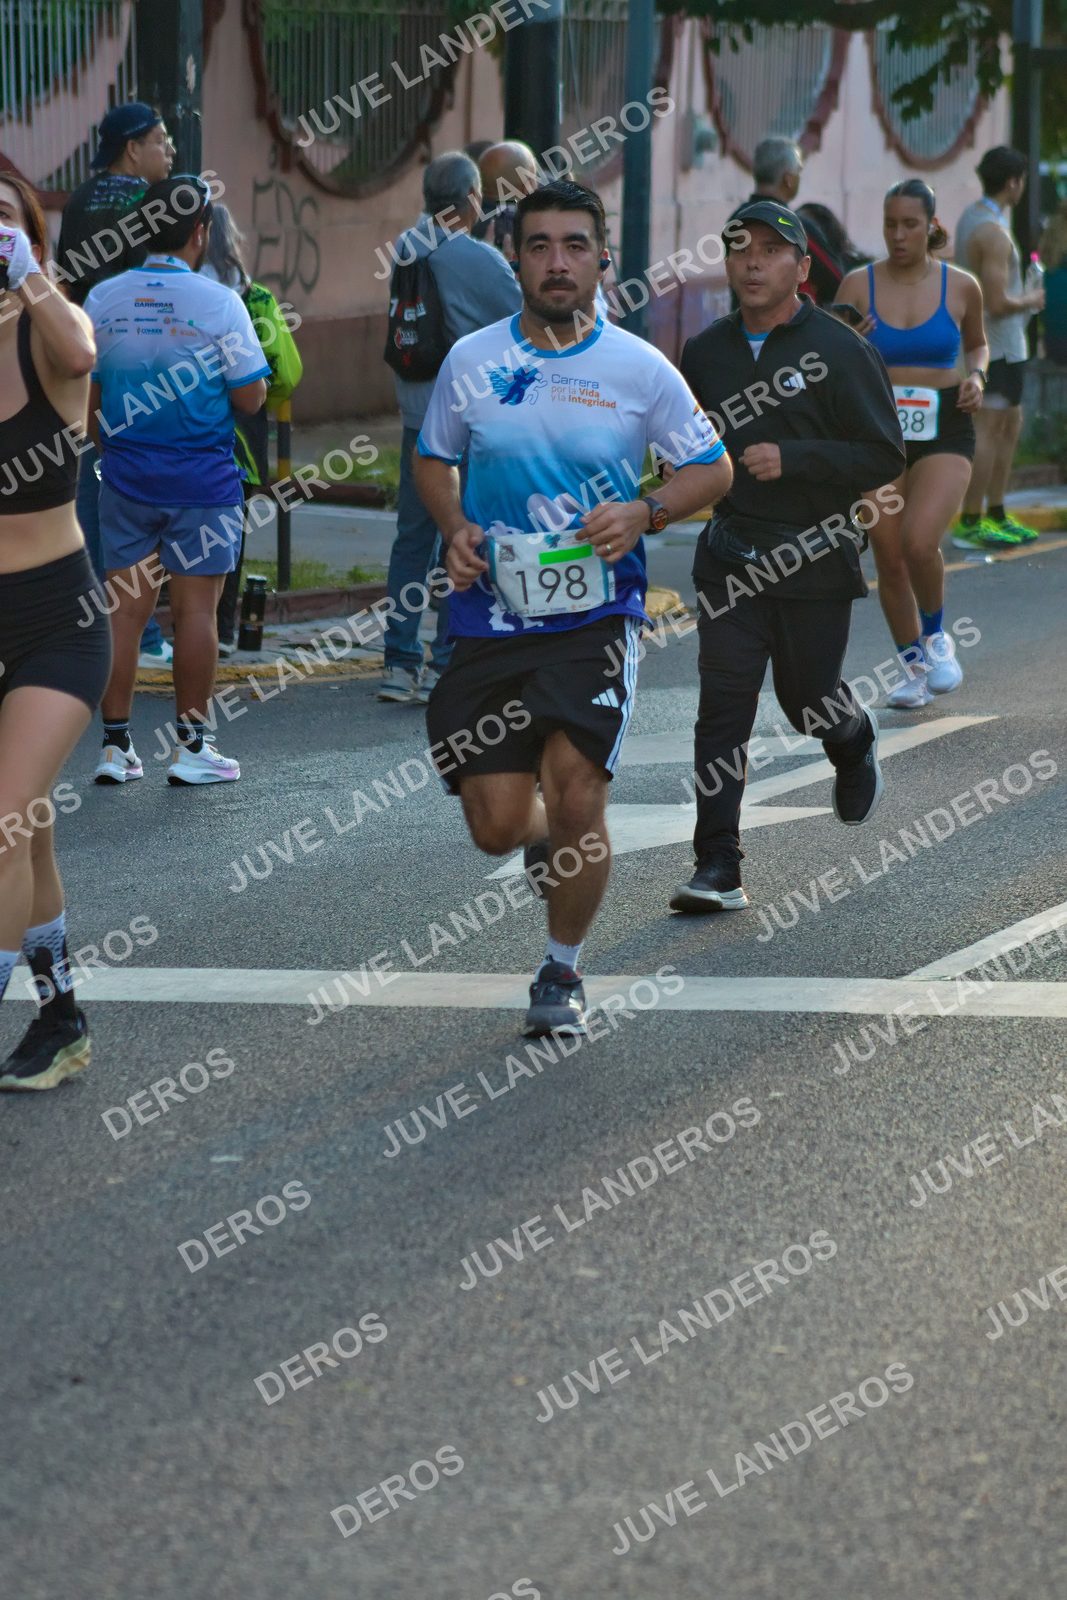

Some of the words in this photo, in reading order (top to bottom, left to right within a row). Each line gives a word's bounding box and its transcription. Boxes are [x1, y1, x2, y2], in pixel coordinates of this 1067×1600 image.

[551, 373, 599, 389] Carrera
[551, 385, 566, 396] por
[568, 387, 576, 395] la
[579, 387, 601, 398] Vida
[568, 394, 617, 408] Integridad
[515, 564, 588, 605] 198
